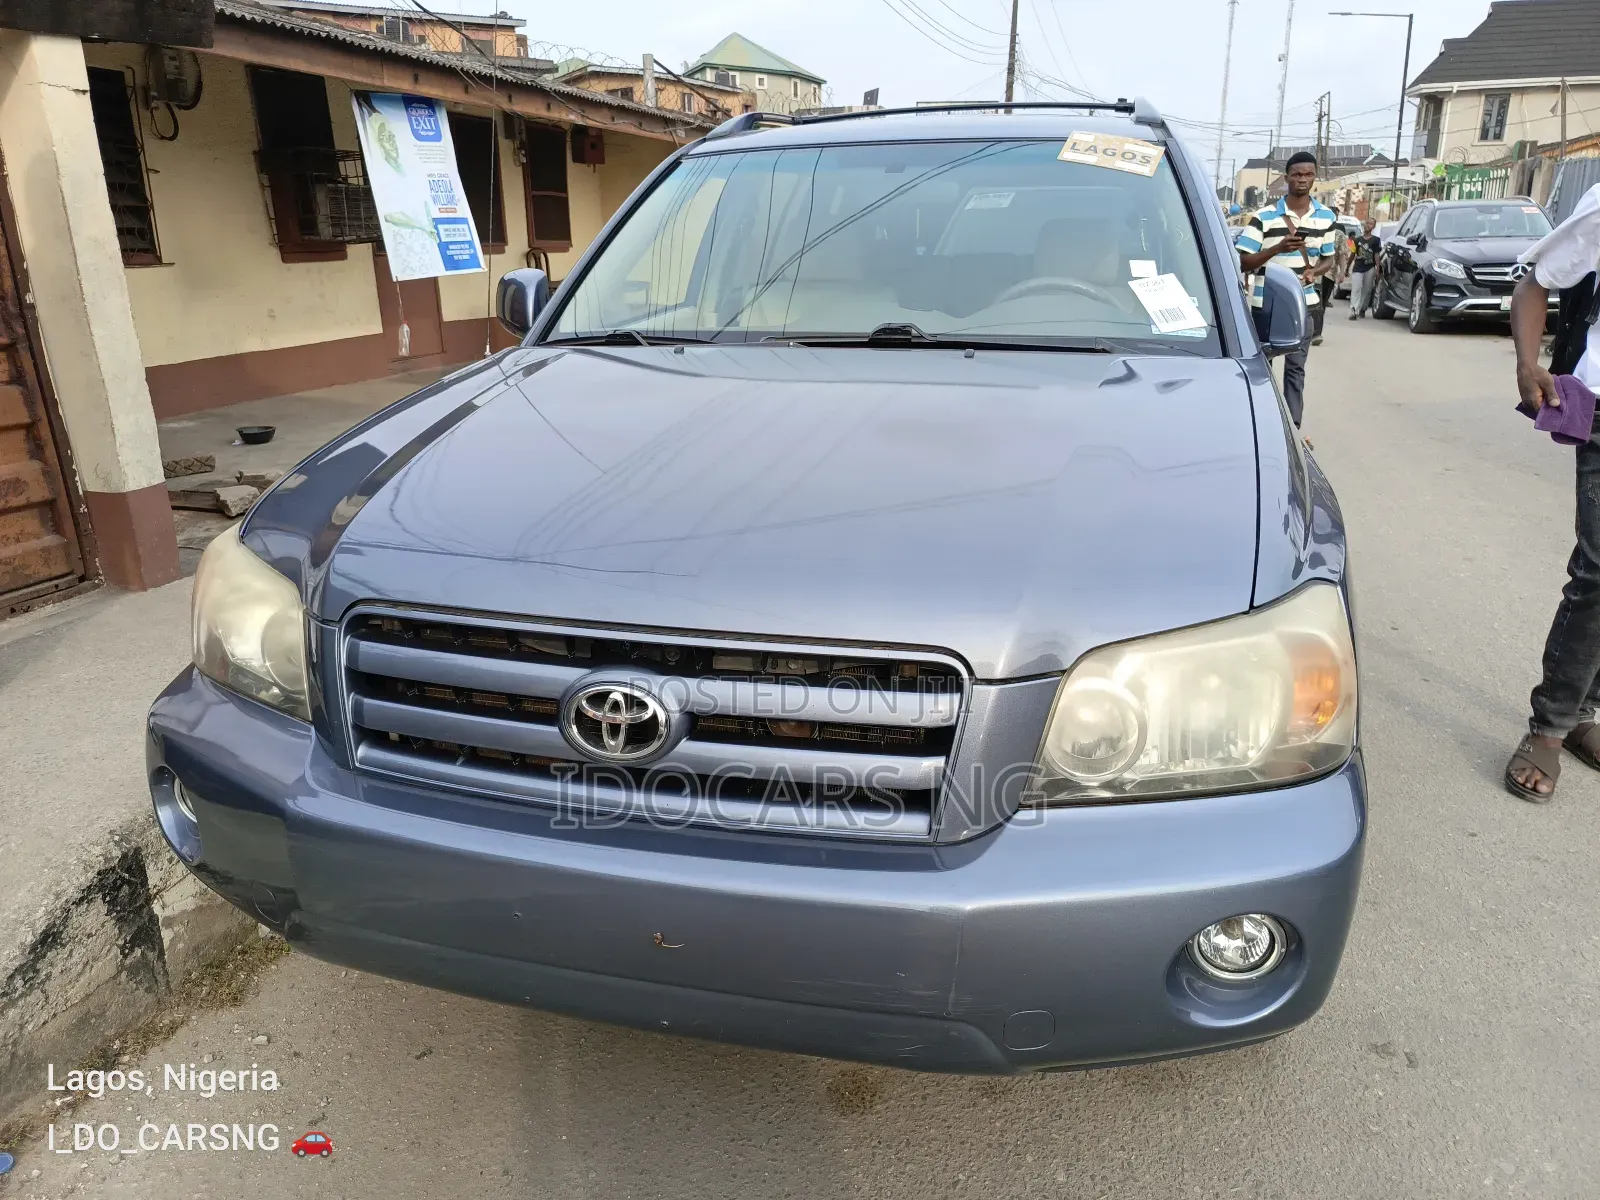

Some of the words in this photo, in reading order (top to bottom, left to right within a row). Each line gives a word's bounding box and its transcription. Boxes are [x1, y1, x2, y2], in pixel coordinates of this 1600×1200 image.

[411, 115, 436, 131] EXIT
[1069, 142, 1153, 165] LAGOS
[428, 179, 454, 194] ADEOLA
